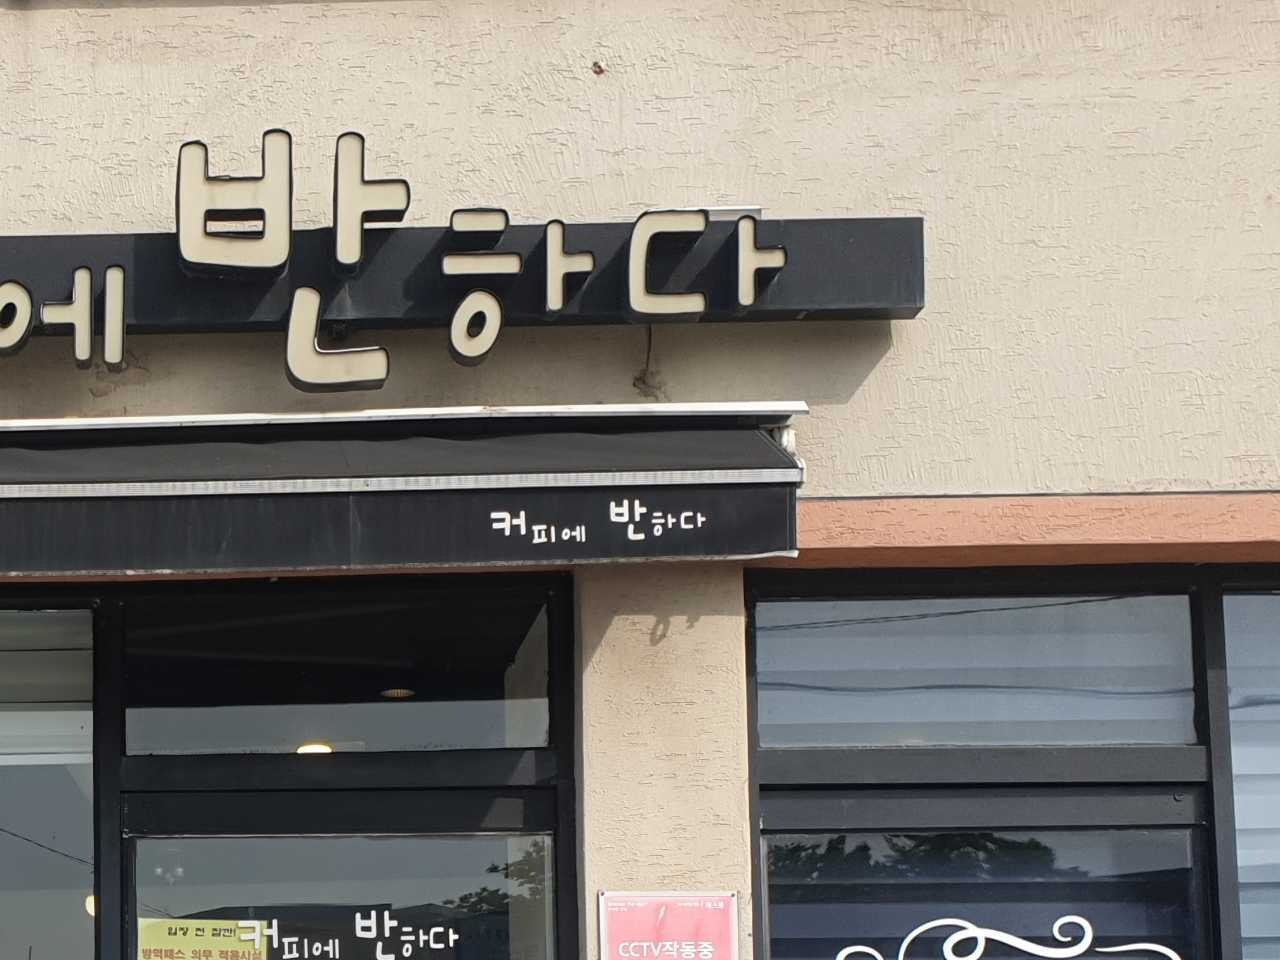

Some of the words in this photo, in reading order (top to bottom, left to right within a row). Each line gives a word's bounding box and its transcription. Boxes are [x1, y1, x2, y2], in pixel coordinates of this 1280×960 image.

[176, 128, 787, 390] 반하다
[490, 510, 586, 544] 커피에
[610, 499, 707, 541] 반하다
[142, 948, 187, 960] 방역패스
[191, 948, 213, 960] 의무
[238, 918, 340, 960] 커피에
[355, 909, 460, 960] 반하다
[618, 940, 715, 960] CCTV작동중
